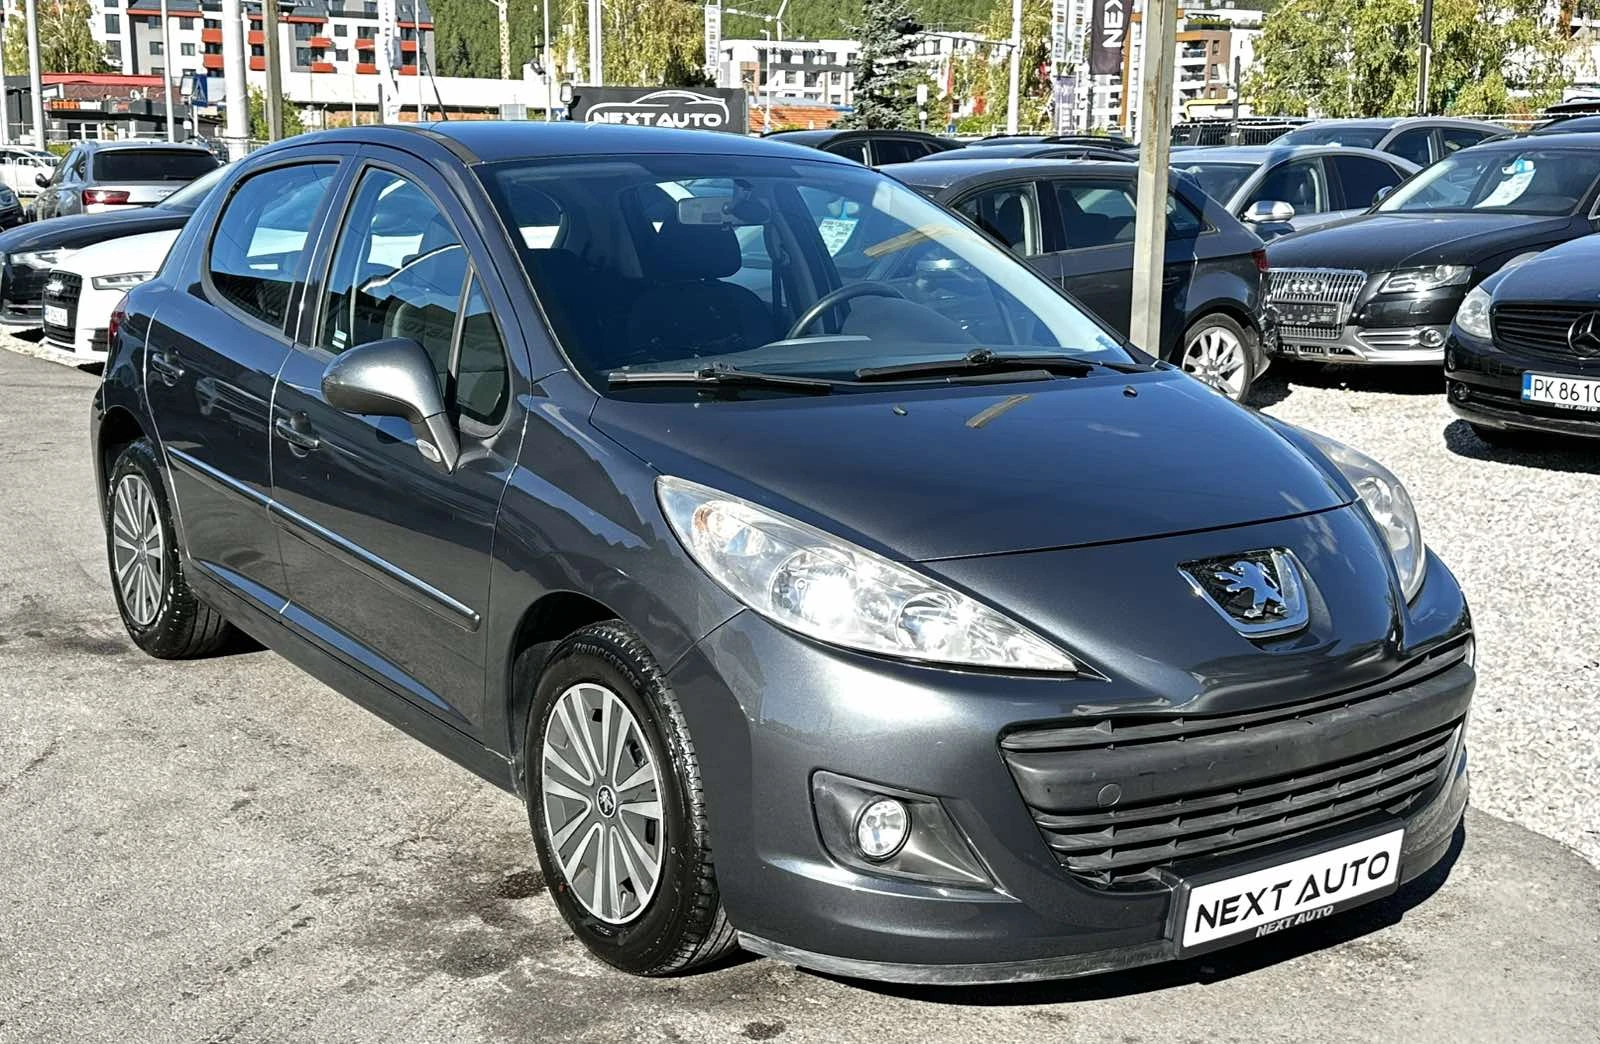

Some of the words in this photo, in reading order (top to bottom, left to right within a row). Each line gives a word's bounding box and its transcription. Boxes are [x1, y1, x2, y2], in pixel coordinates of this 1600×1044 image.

[593, 111, 655, 125] NEXT
[655, 112, 722, 128] AUTO
[1534, 379, 1555, 399] PK
[1194, 879, 1292, 933] NEXT
[1295, 850, 1390, 905] AUTO
[1255, 915, 1296, 938] NEXT
[1294, 904, 1335, 926] AUTO
